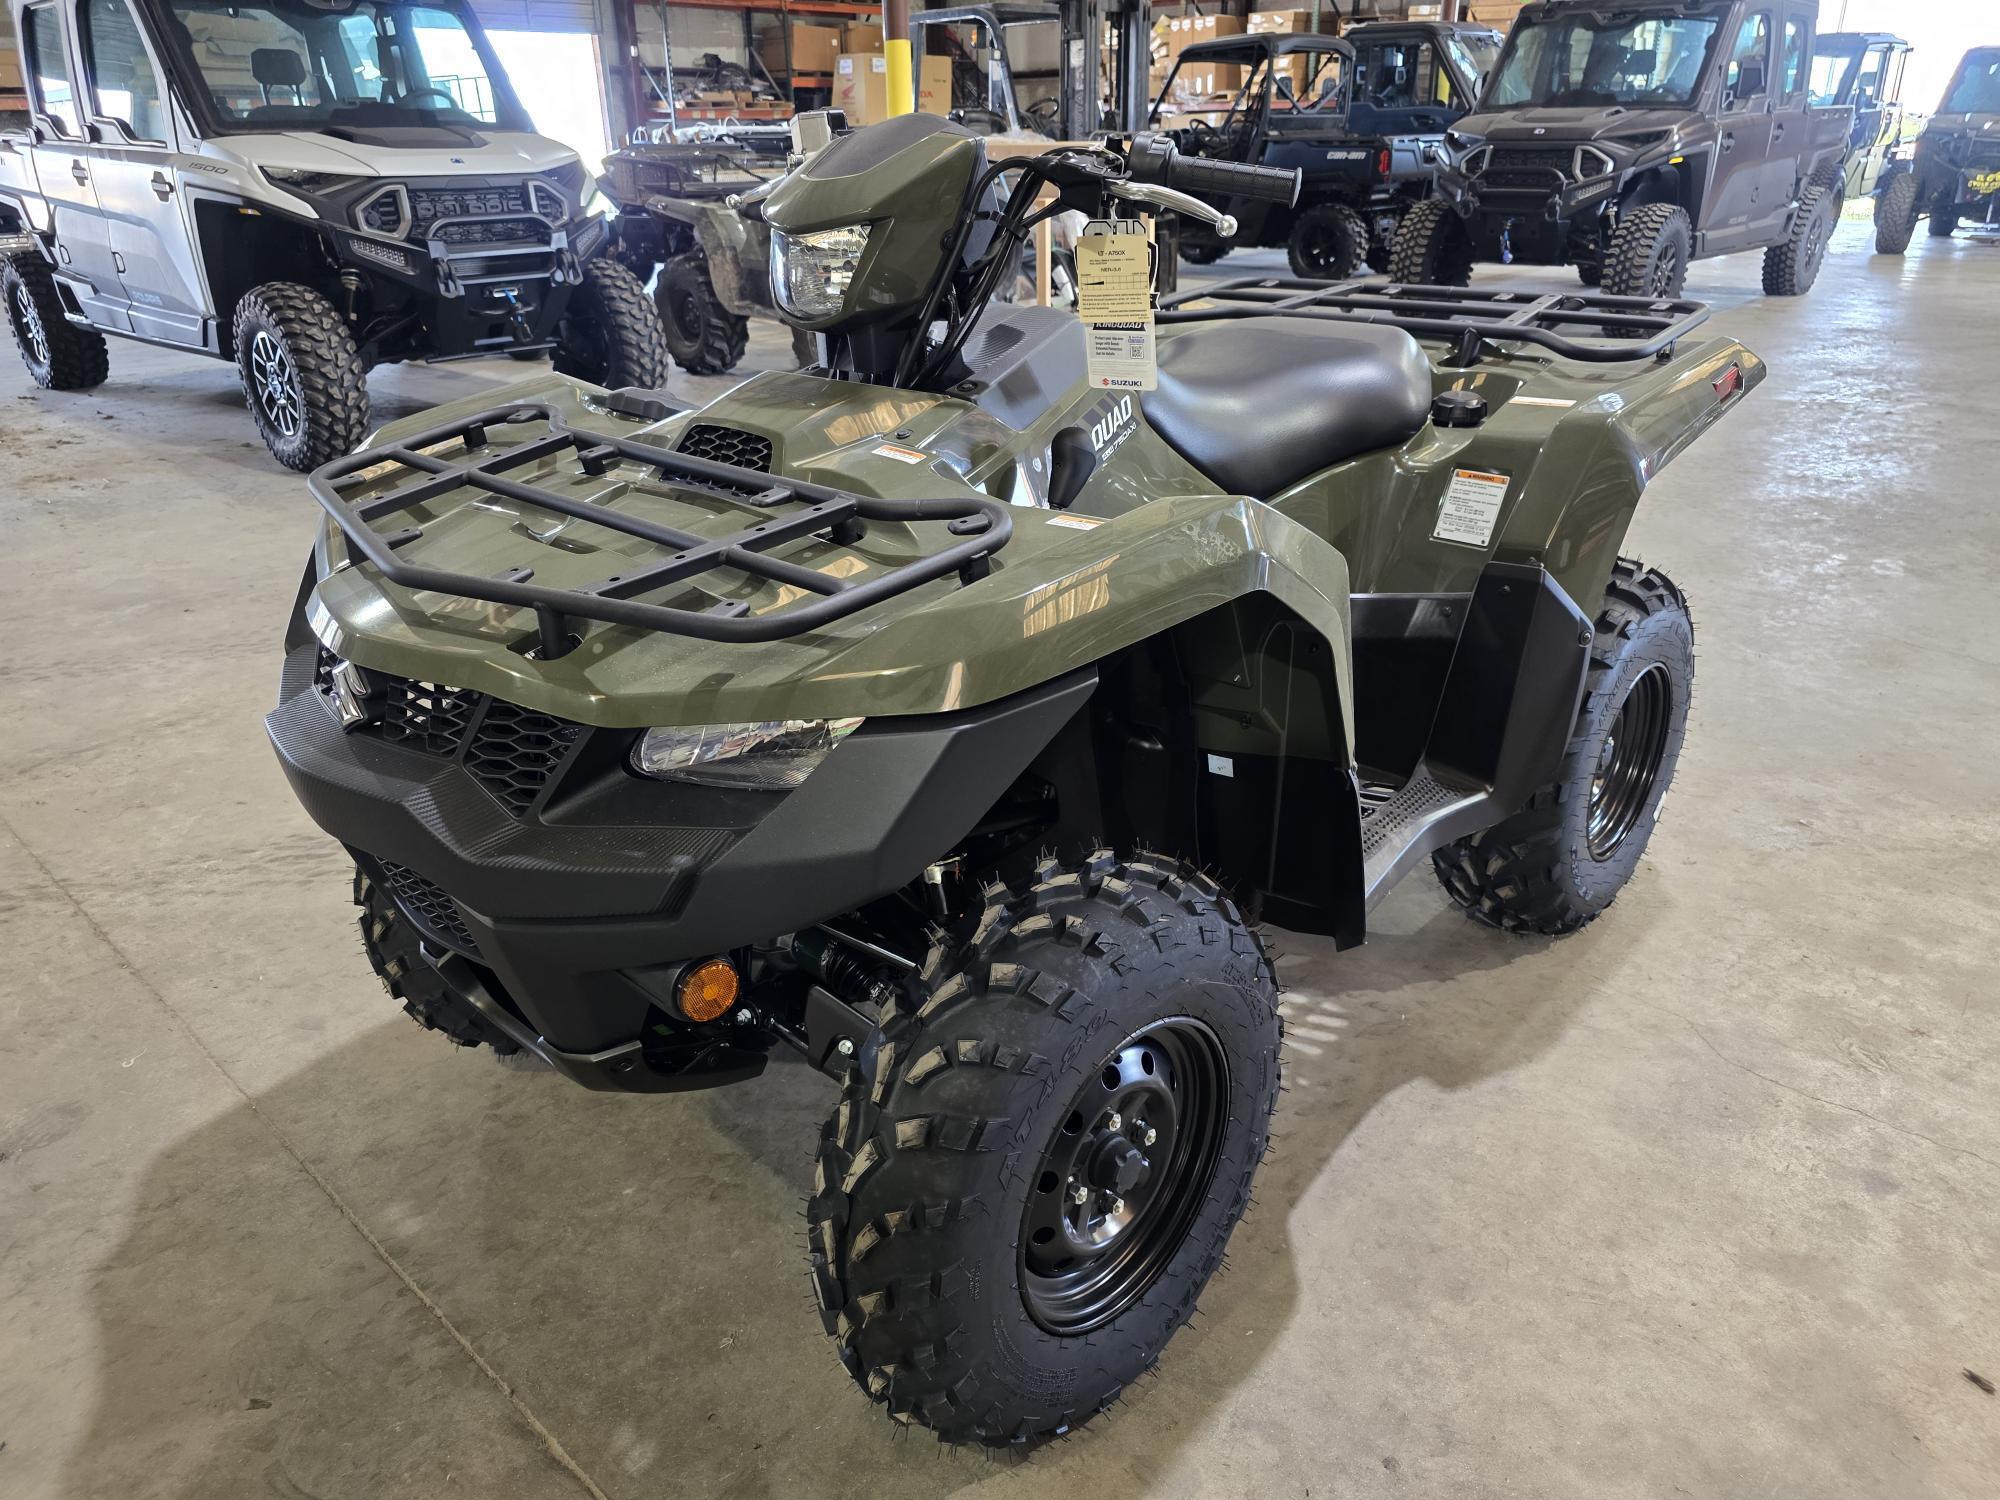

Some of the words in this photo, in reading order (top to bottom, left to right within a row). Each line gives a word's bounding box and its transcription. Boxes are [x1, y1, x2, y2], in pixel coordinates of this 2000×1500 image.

[188, 162, 229, 175] 1500
[1111, 379, 1143, 387] SUZUKI
[1091, 394, 1132, 452] QUAD
